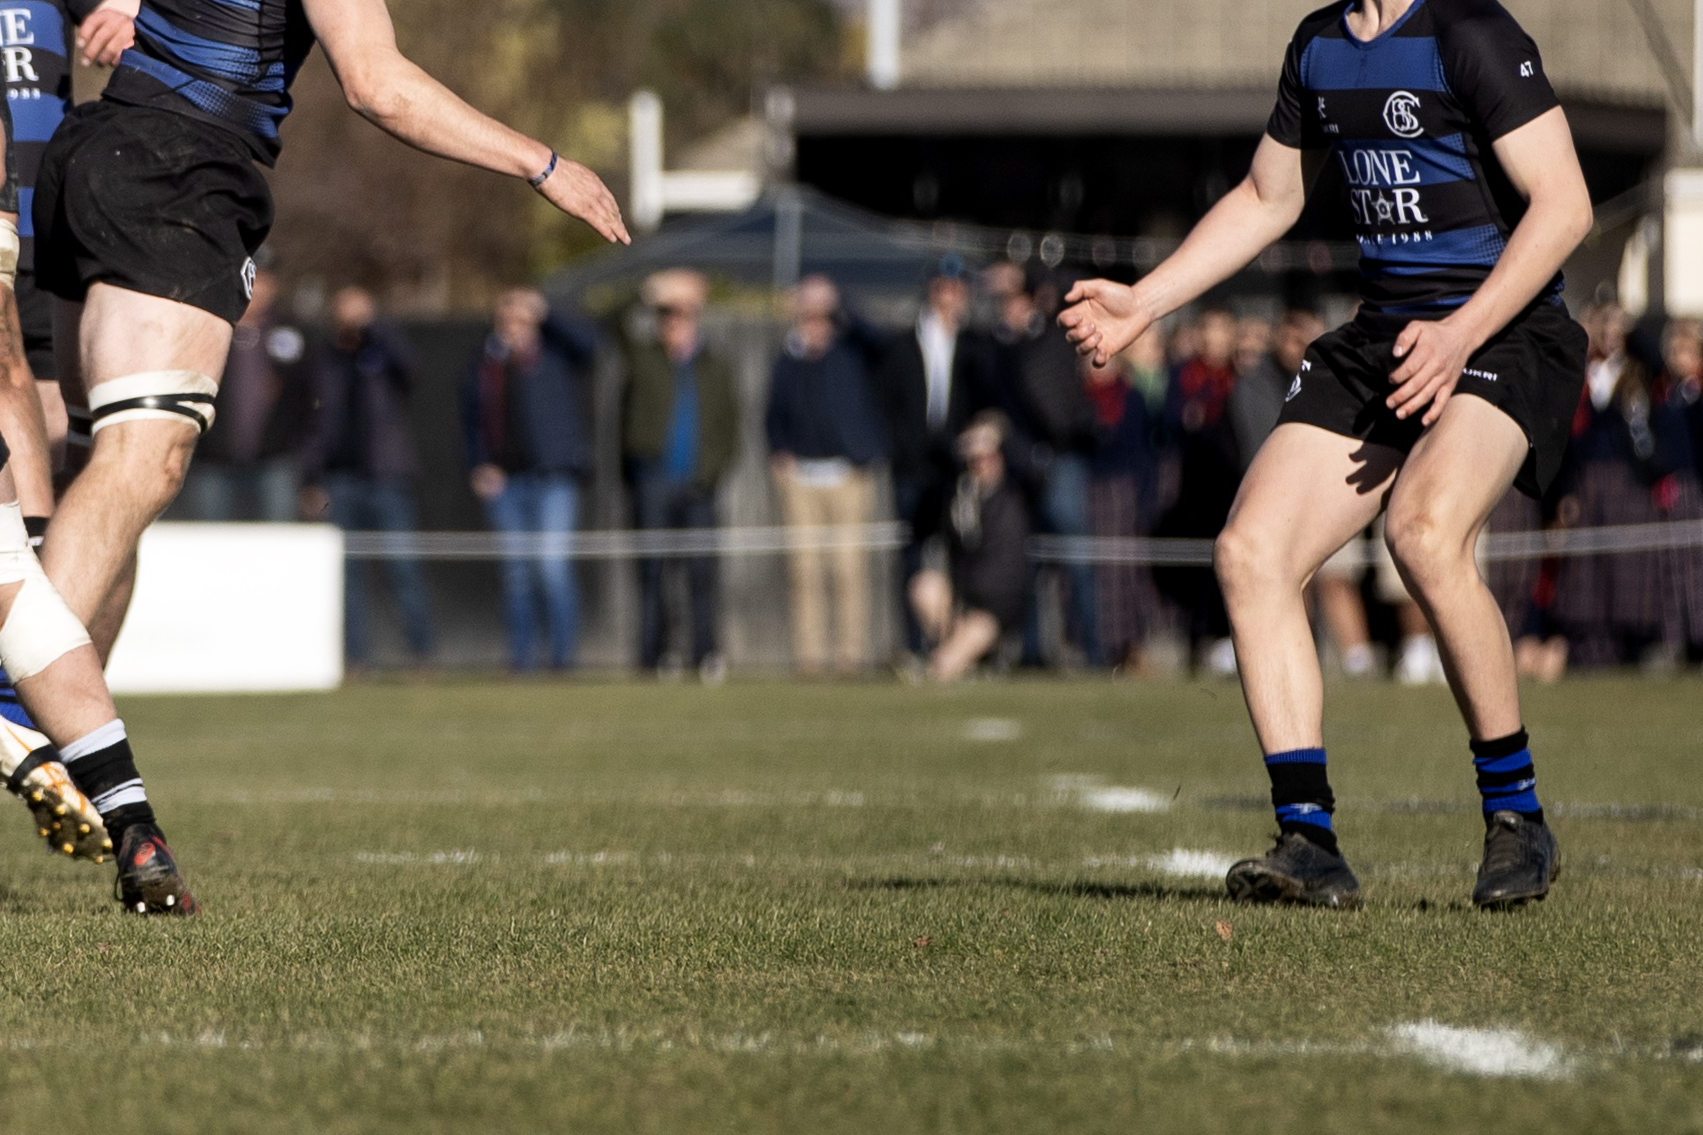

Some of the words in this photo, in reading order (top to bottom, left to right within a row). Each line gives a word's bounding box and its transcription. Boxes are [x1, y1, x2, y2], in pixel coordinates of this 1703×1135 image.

[1520, 60, 1534, 78] 47
[1338, 149, 1421, 186] LONE
[1392, 231, 1433, 245] 1988
[1462, 367, 1498, 382] UKRI
